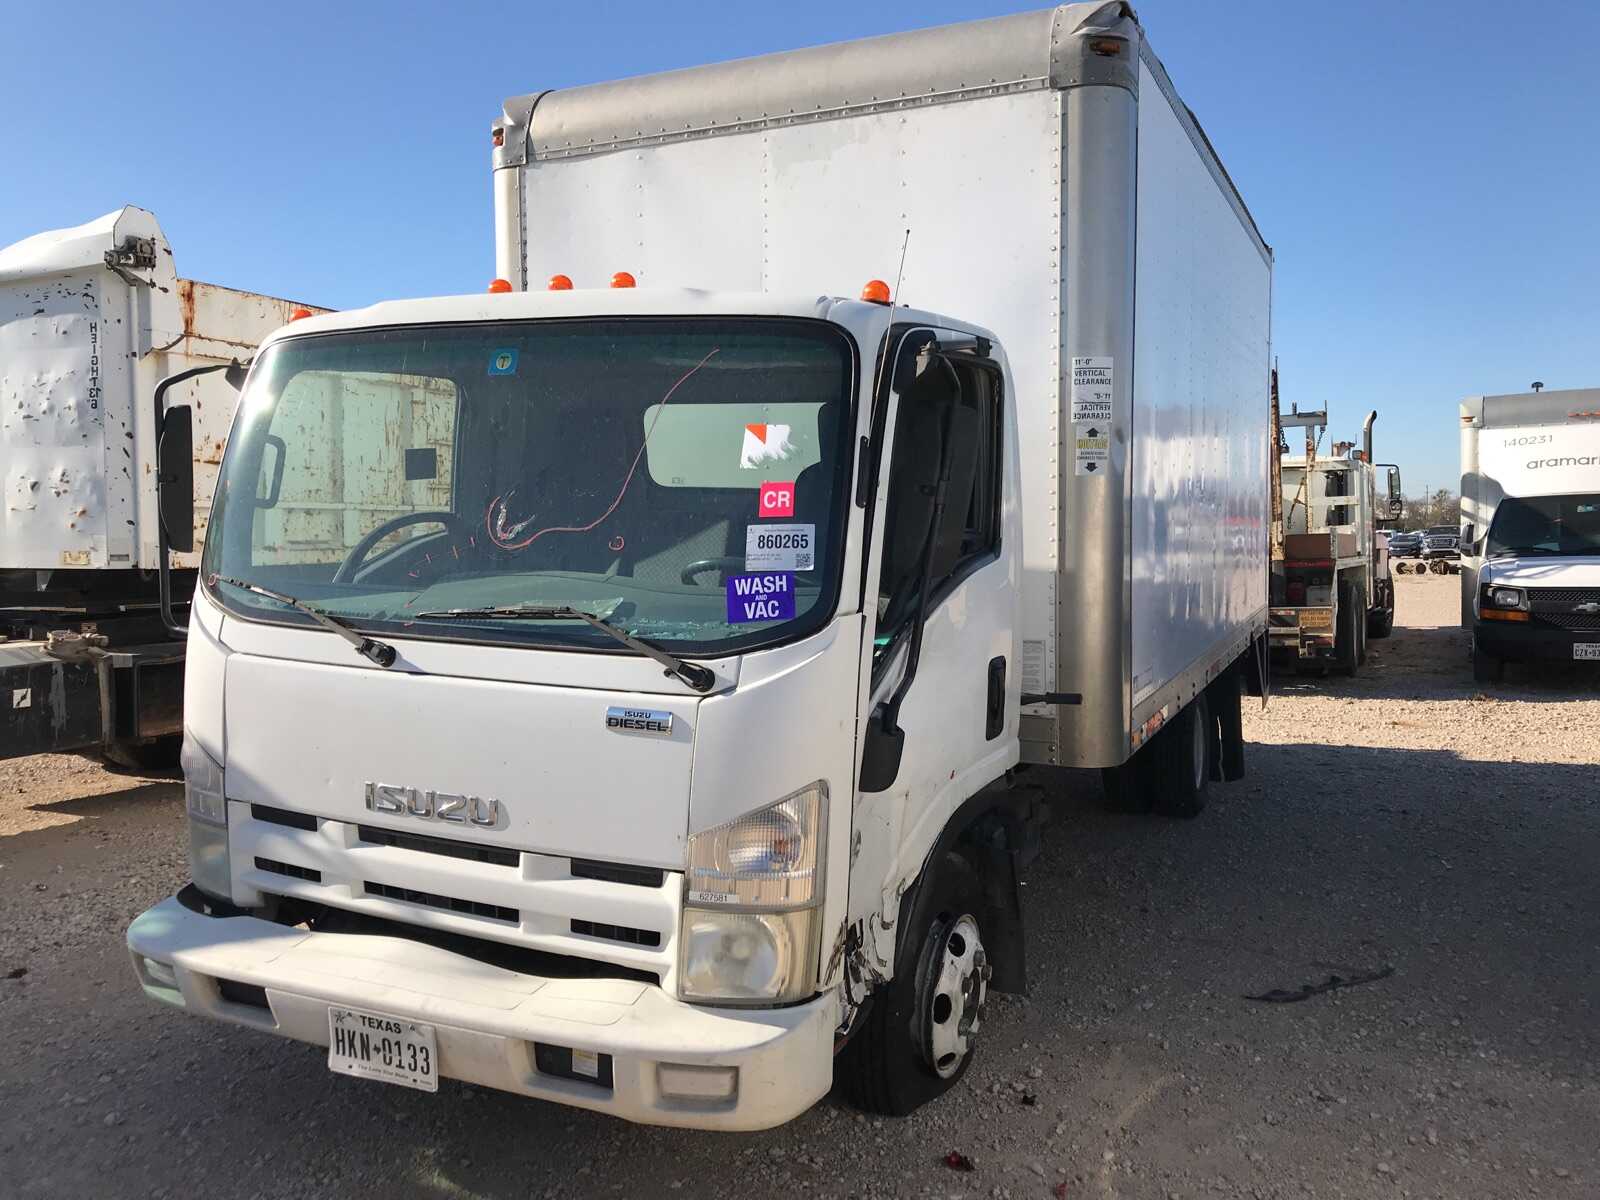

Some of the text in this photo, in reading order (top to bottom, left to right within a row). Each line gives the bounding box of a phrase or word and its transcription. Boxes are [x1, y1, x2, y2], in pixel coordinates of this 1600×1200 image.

[1074, 369, 1106, 377] VERTICAL
[1073, 378, 1112, 386] CLEARANCE
[1503, 434, 1553, 449] 140231
[763, 490, 791, 509] CR
[757, 534, 809, 549] 860265
[734, 575, 788, 596] WASH
[755, 594, 768, 602] AND
[743, 600, 780, 620] VAC
[624, 710, 651, 719] ISUZU
[607, 717, 670, 732] DIESEL
[364, 781, 500, 828] ISUZU
[359, 1014, 402, 1034] TEXAS
